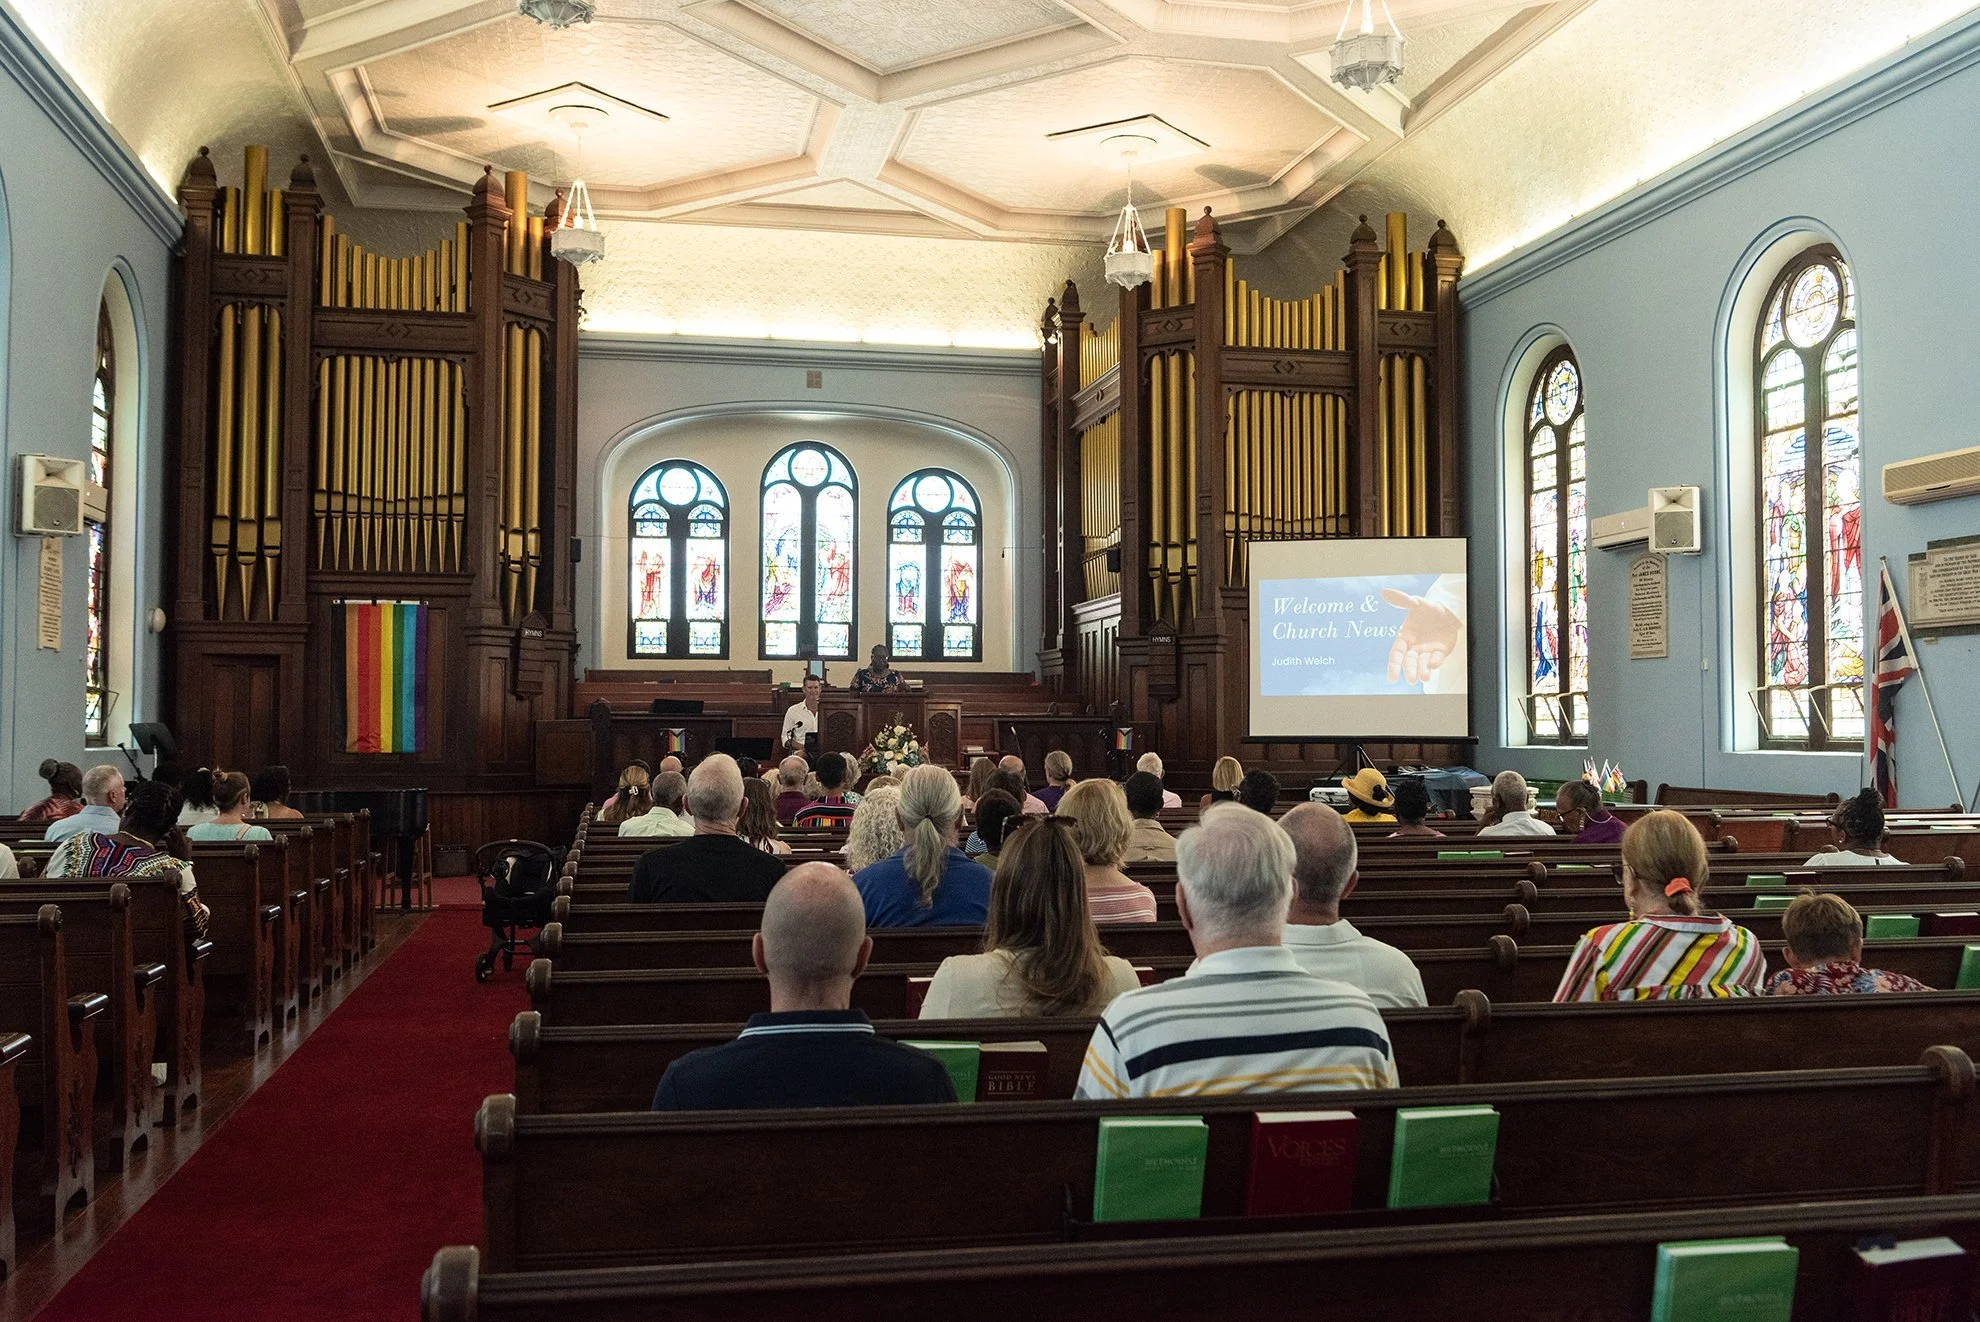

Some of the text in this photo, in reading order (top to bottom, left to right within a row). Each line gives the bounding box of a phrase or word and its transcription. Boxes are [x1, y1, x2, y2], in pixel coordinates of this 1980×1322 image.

[1273, 594, 1378, 615] Welcome &
[1272, 622, 1338, 640] Church
[1271, 656, 1335, 667] Judith Welch
[988, 1081, 1036, 1091] BIBLE
